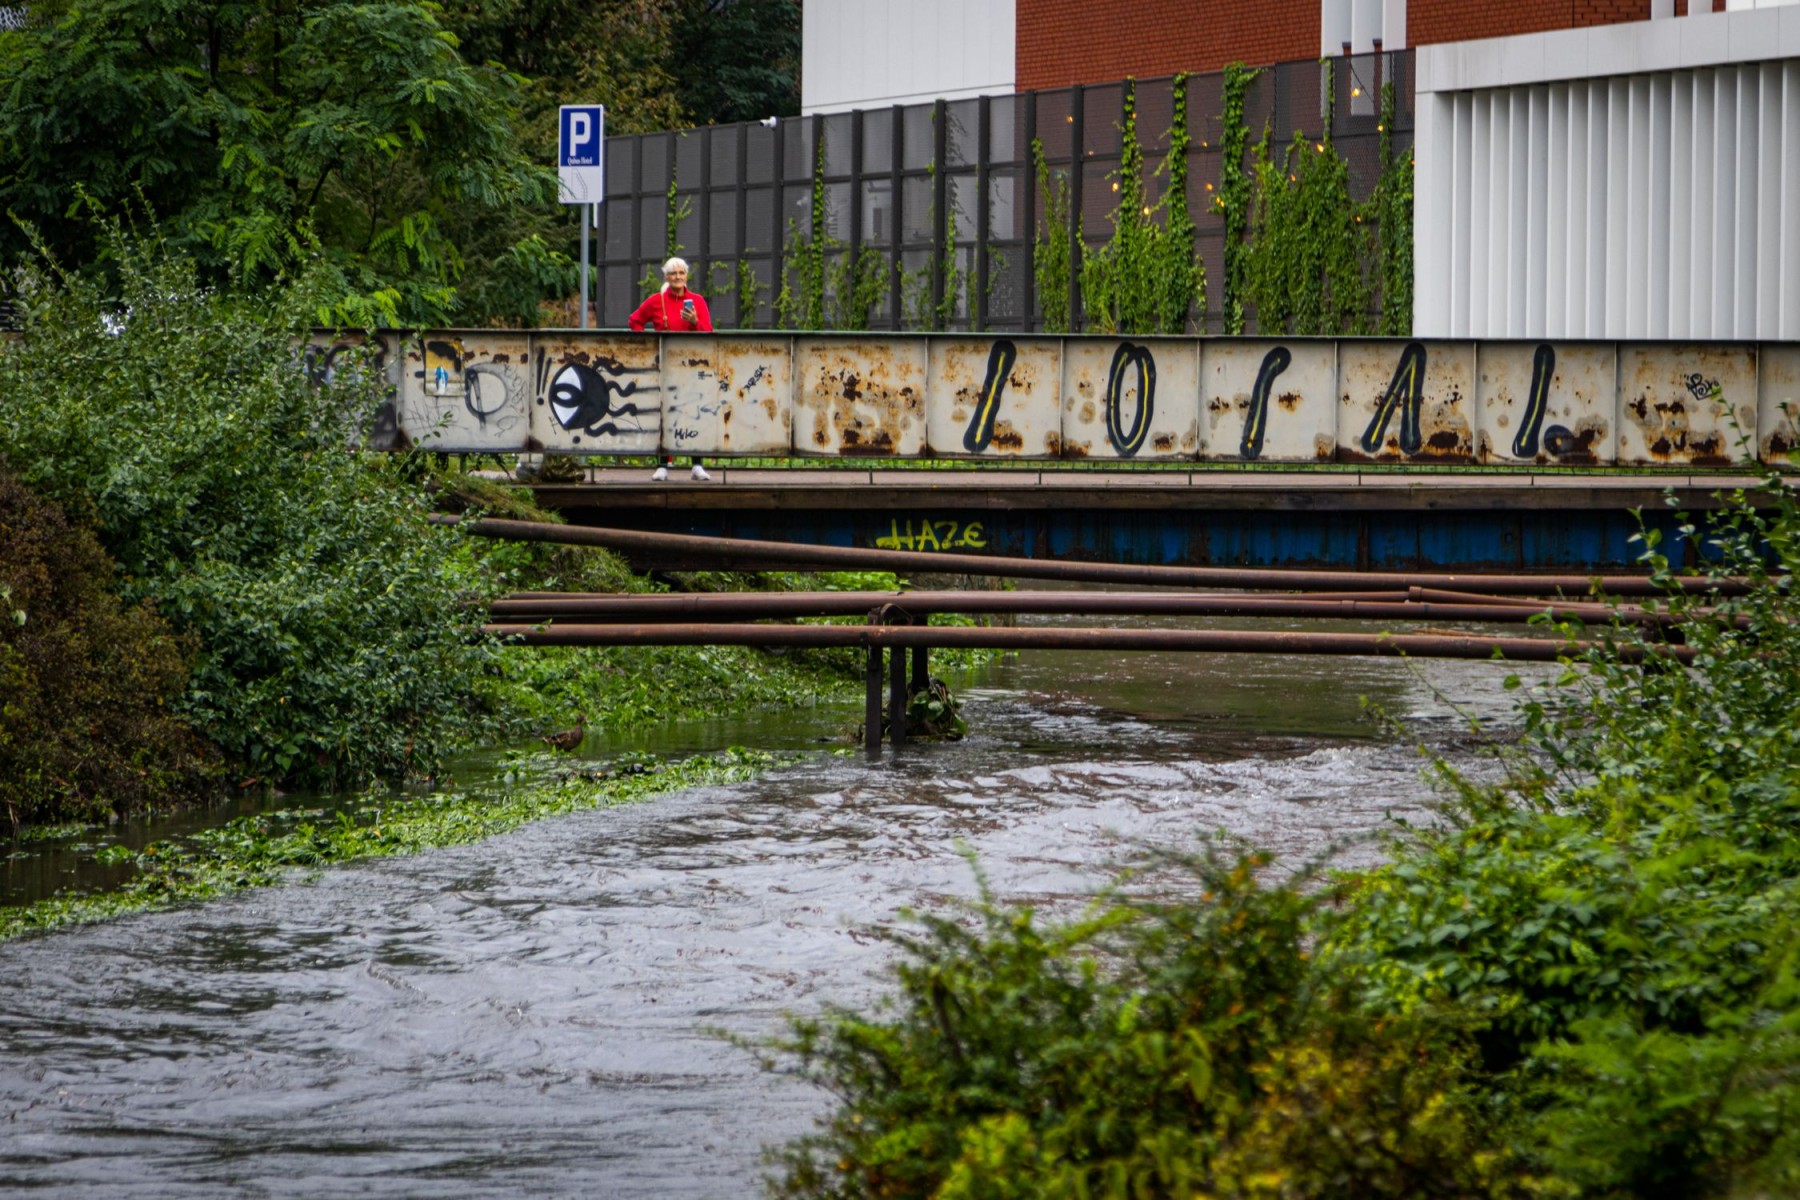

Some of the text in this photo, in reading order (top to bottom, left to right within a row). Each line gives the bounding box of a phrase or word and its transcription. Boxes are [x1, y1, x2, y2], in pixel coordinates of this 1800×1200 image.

[570, 112, 591, 156] P
[580, 156, 592, 164] Hotel
[875, 518, 987, 551] HAZE
